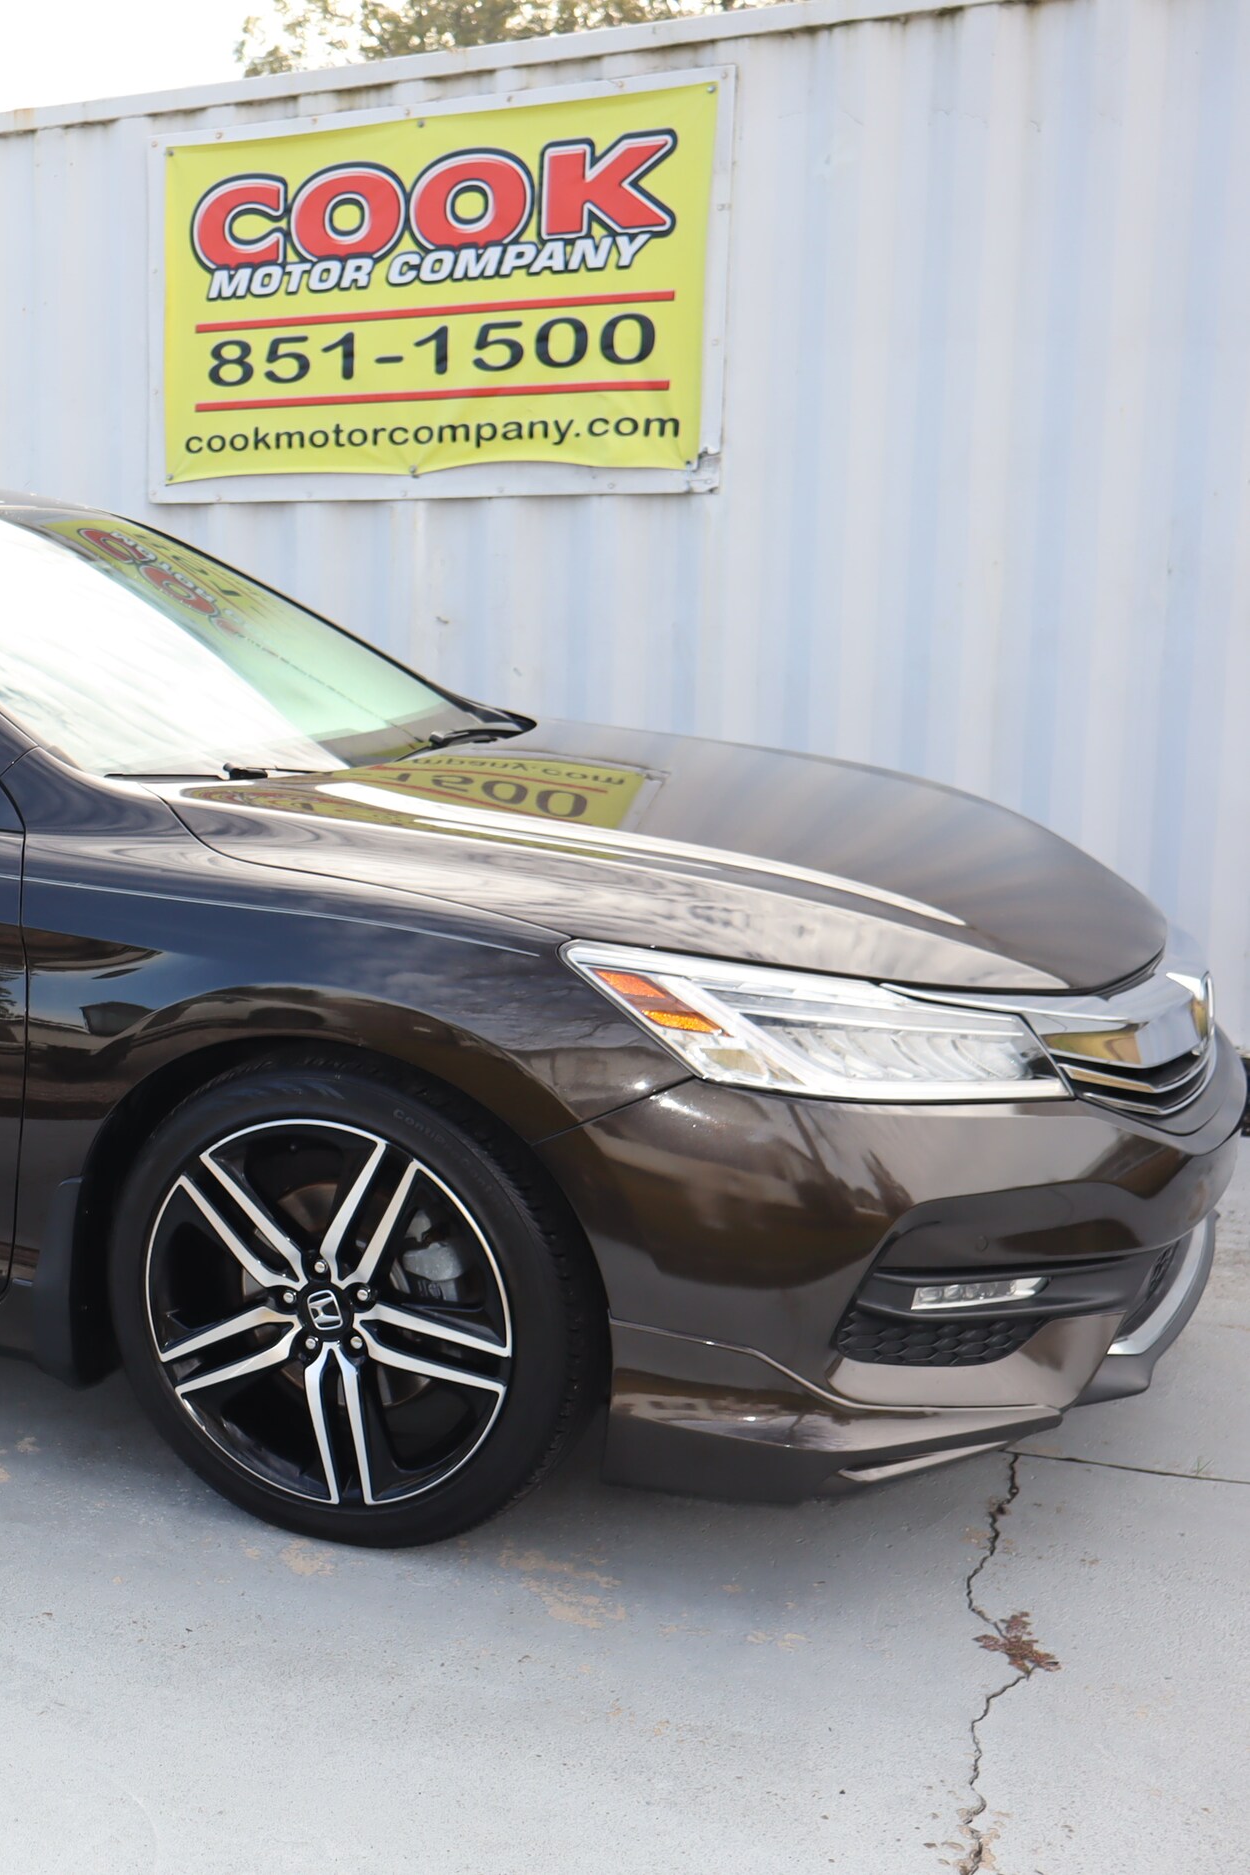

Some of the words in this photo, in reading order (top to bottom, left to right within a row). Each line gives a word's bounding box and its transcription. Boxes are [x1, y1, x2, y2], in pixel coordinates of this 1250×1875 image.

[190, 128, 678, 274] COOK
[206, 257, 375, 301] MOTOR
[386, 232, 651, 287] COMPANY
[207, 312, 656, 387] 851-1500
[184, 413, 681, 455] cookmotorcompany.com
